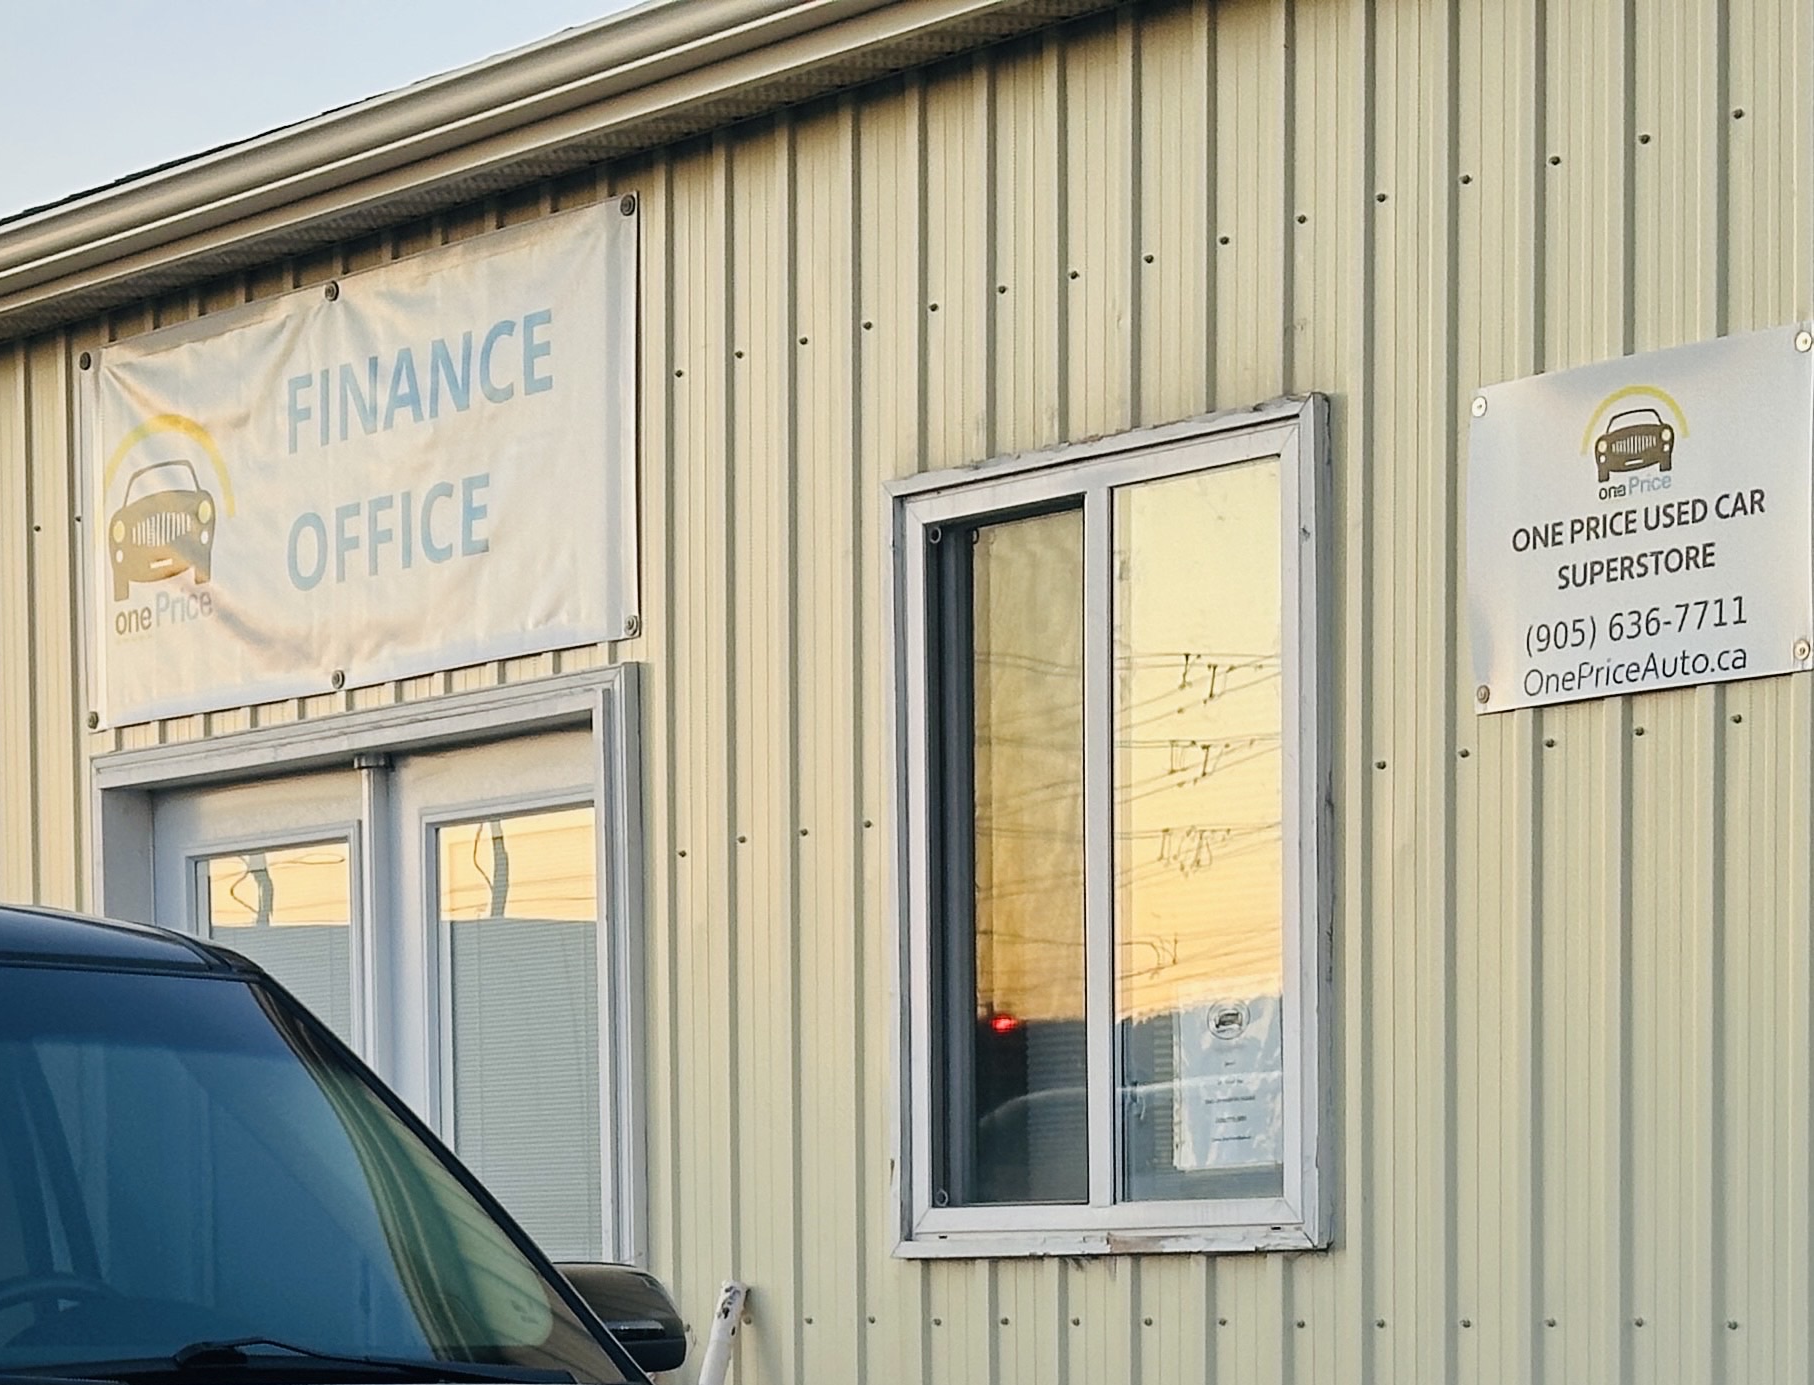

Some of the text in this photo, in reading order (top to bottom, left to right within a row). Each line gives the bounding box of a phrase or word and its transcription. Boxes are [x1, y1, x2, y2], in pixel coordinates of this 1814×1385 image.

[288, 309, 553, 454] FINANCE
[1629, 475, 1672, 495] Price
[287, 472, 490, 592] OFFICE
[1511, 489, 1765, 553] ONE PRICE USED CAR
[1557, 543, 1716, 589] SUPERSTORE
[115, 590, 214, 635] one Price
[1525, 595, 1748, 658] (905) 636-7711
[1523, 648, 1747, 696] OnePriceAuto.ca
